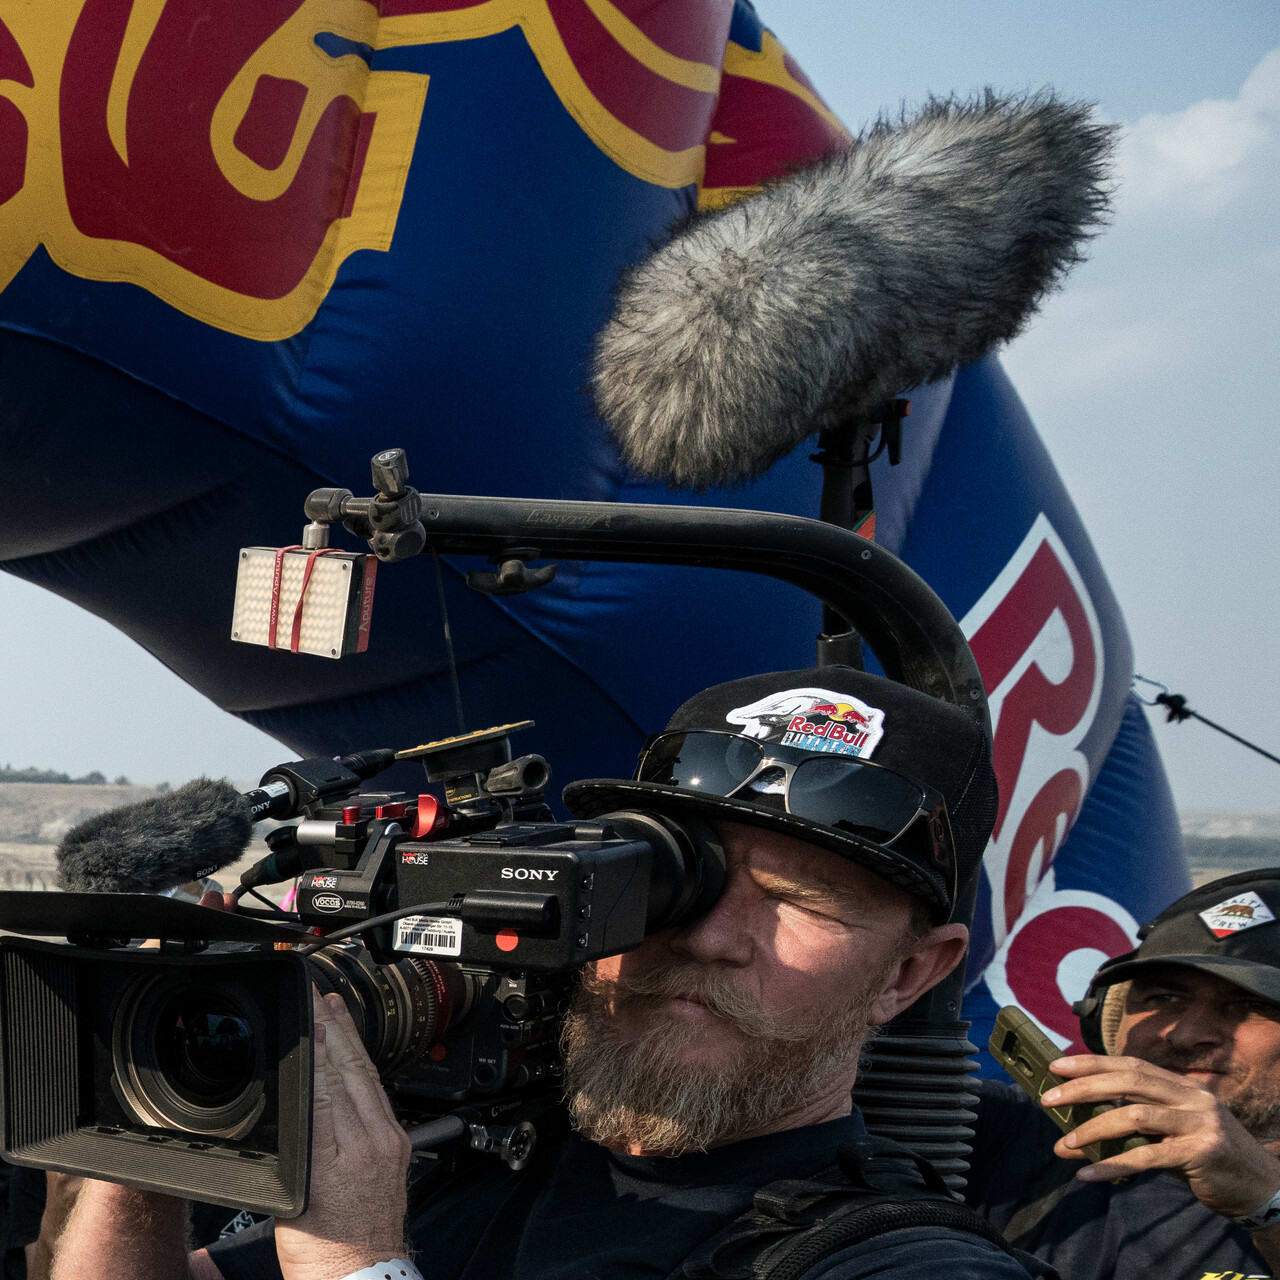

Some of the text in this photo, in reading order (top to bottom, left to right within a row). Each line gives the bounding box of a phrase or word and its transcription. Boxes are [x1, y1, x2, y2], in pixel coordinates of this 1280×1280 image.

[788, 716, 870, 748] Red Bull
[500, 866, 559, 882] SONY
